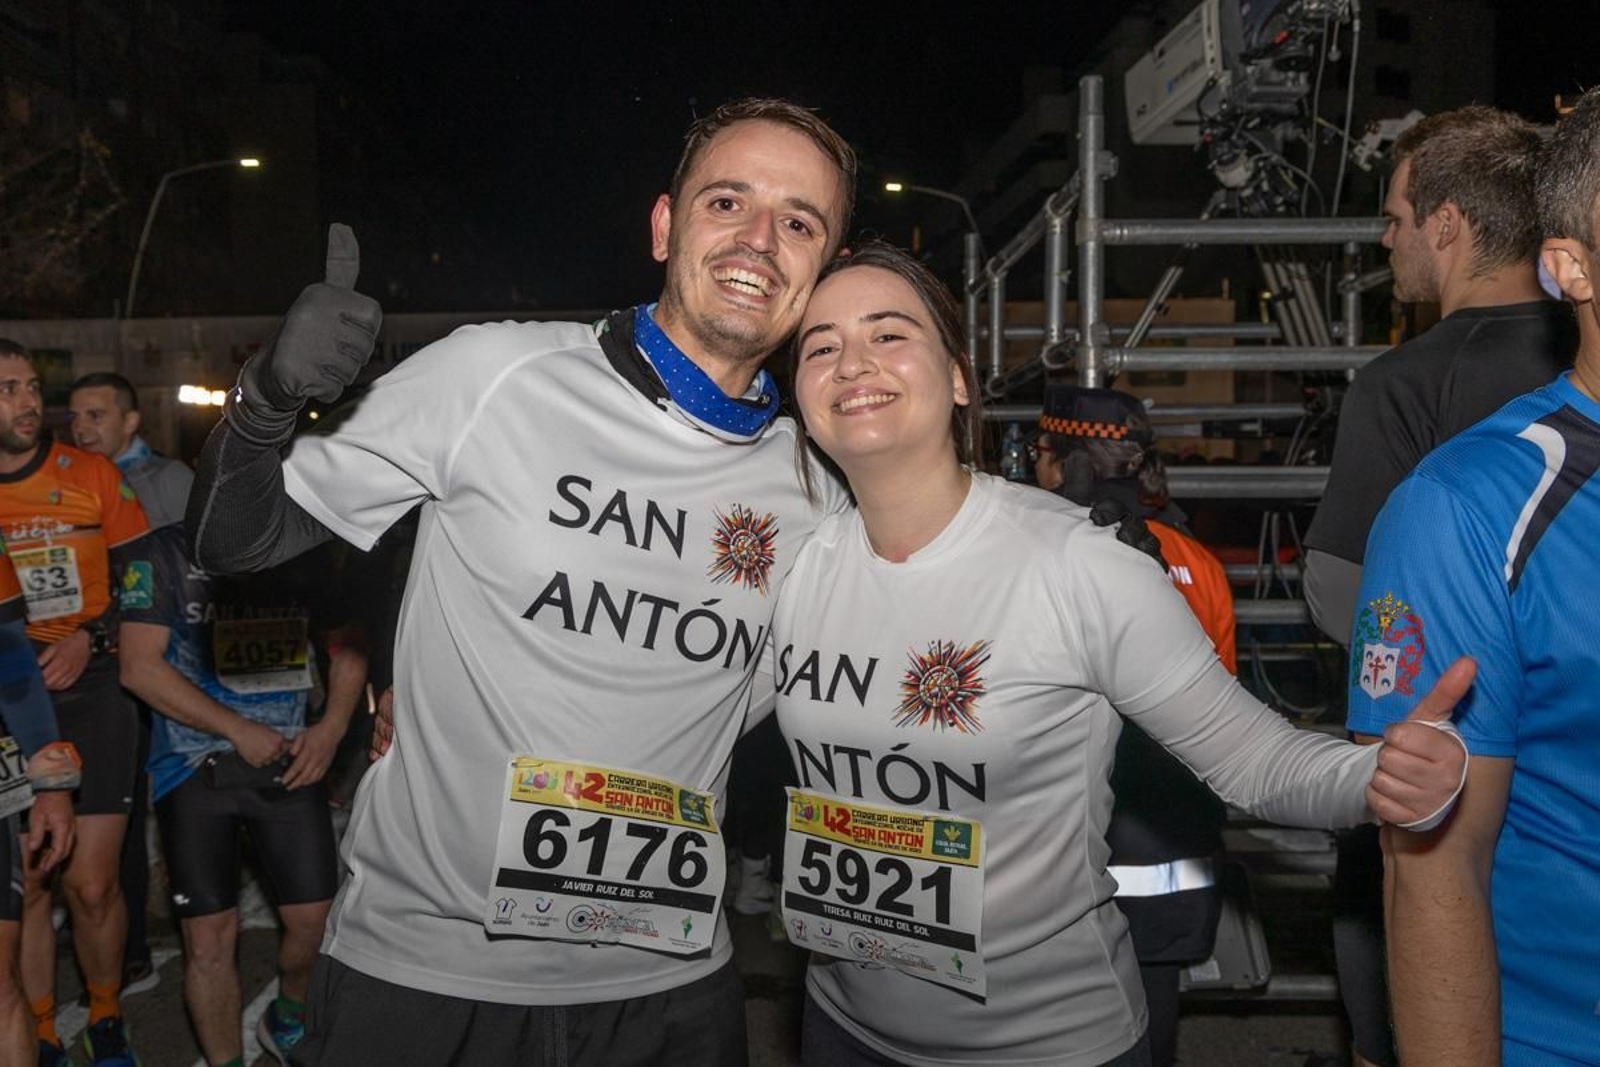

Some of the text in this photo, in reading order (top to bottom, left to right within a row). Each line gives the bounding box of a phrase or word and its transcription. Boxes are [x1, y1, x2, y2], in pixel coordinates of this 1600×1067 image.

[548, 474, 688, 561] SAN
[520, 570, 765, 672] ANTÓN
[775, 643, 880, 708] SAN
[563, 769, 606, 804] 42
[608, 773, 647, 787] CARRERA
[794, 738, 987, 811] NTÓN
[605, 790, 674, 815] SAN ANTON
[852, 810, 925, 827] CARRERA URBANA
[822, 805, 851, 838] 42
[852, 825, 924, 848] SAN ANTON
[523, 808, 709, 889] 6176
[561, 879, 655, 900] JAVIER RUIZ DEL SOL
[798, 838, 953, 925] 5921
[823, 904, 931, 937] TERESA RUIZ RUIZ DEL SOL
